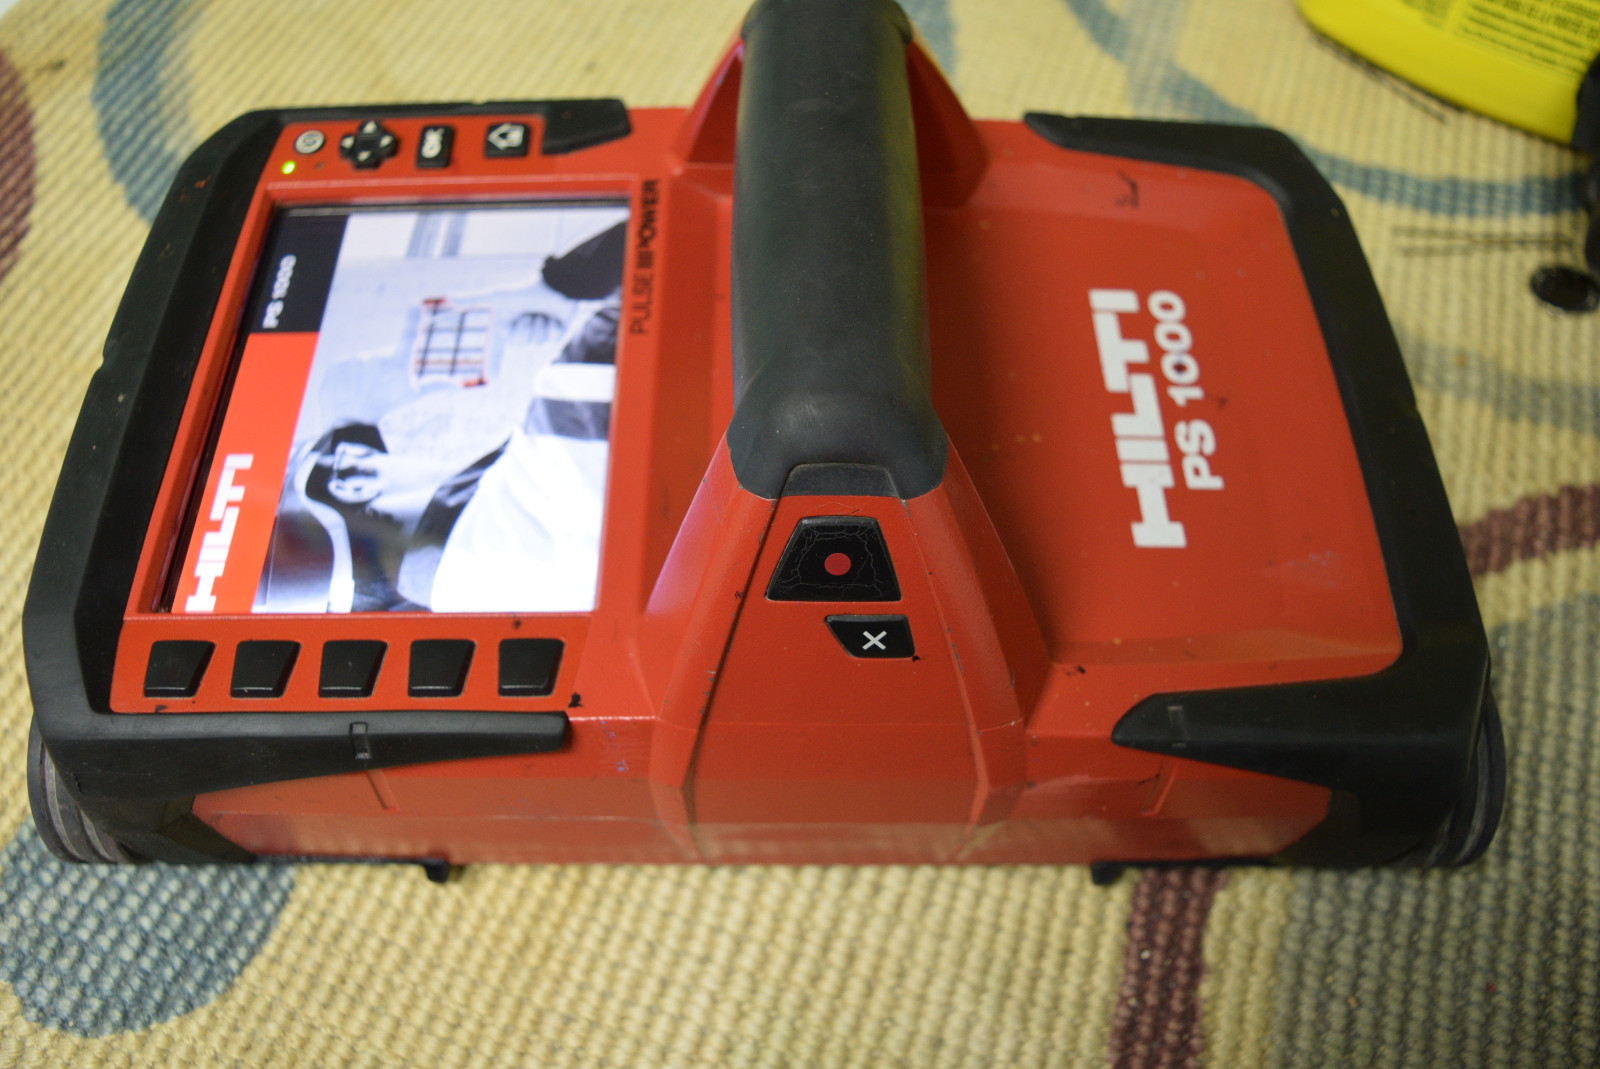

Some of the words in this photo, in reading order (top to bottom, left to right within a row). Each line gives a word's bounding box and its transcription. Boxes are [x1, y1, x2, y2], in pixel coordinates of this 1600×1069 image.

[420, 127, 445, 159] OK
[638, 179, 660, 249] POWER
[262, 300, 285, 329] PS
[630, 271, 654, 336] PULSE
[1147, 289, 1205, 408] 1000
[1087, 288, 1188, 549] HILTI
[1174, 418, 1225, 491] PS
[185, 454, 254, 614] HILTI
